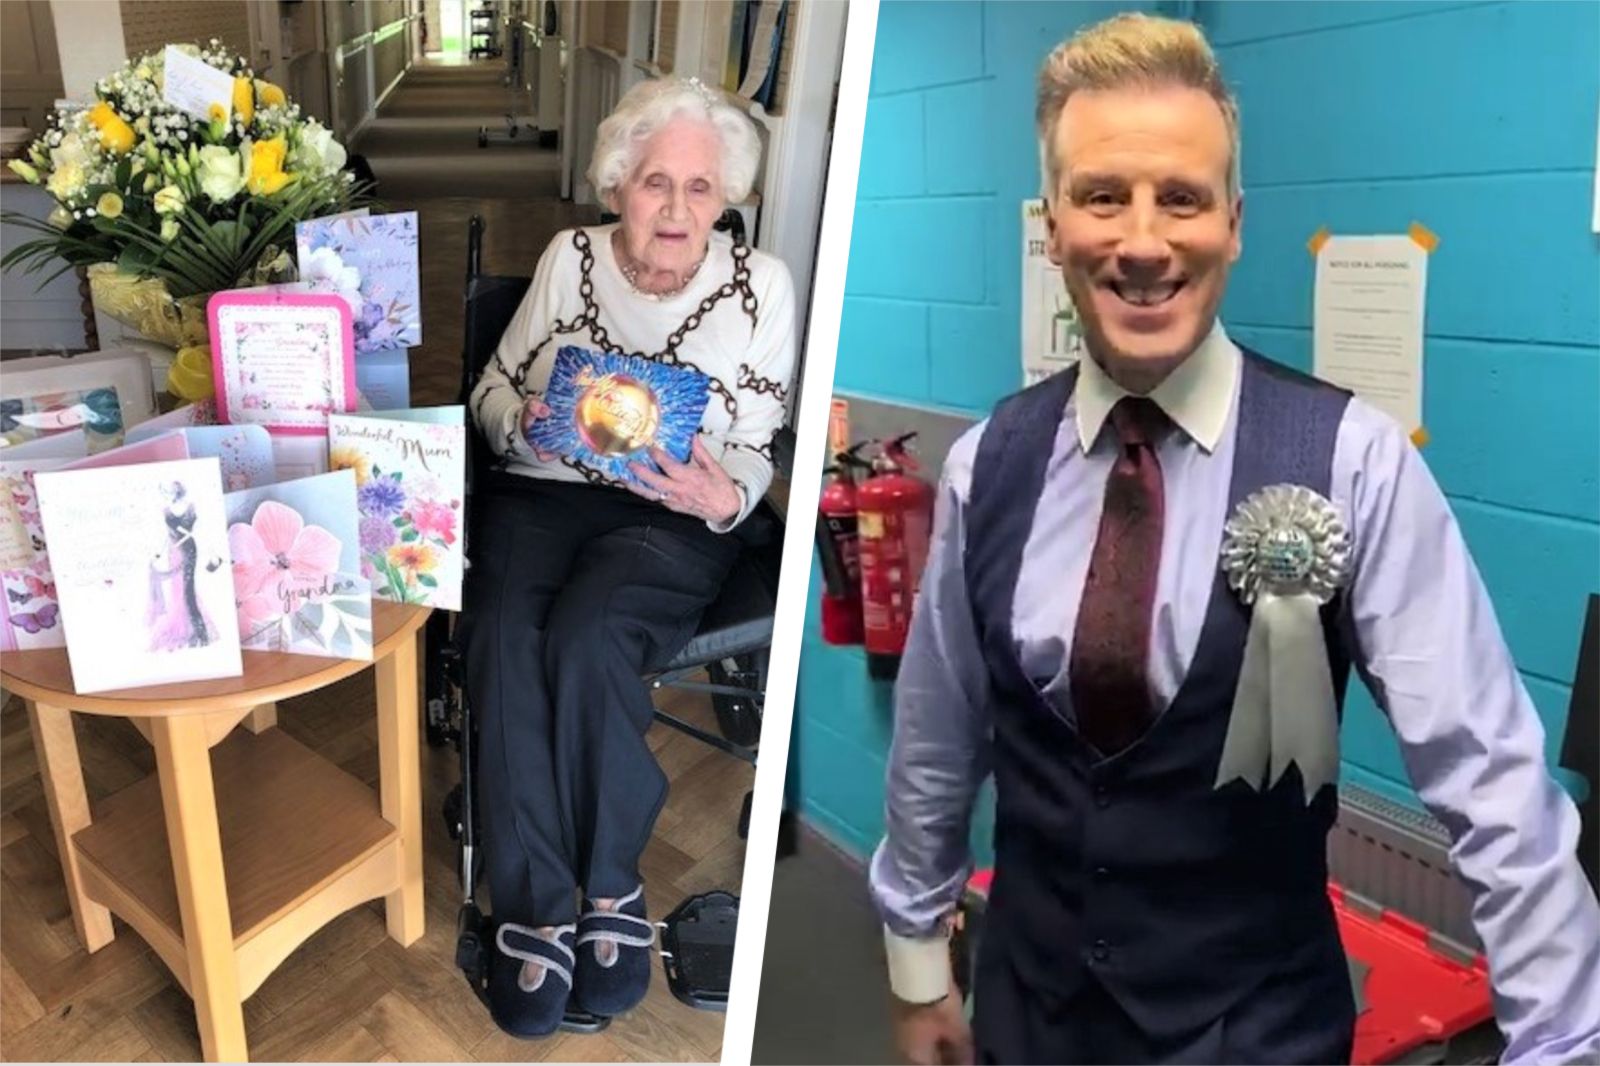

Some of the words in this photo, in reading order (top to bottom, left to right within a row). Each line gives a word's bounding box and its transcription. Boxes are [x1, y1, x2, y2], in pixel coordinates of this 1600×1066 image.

[334, 424, 394, 443] Wonderful
[396, 437, 453, 472] Mum
[277, 575, 358, 614] Grandma
